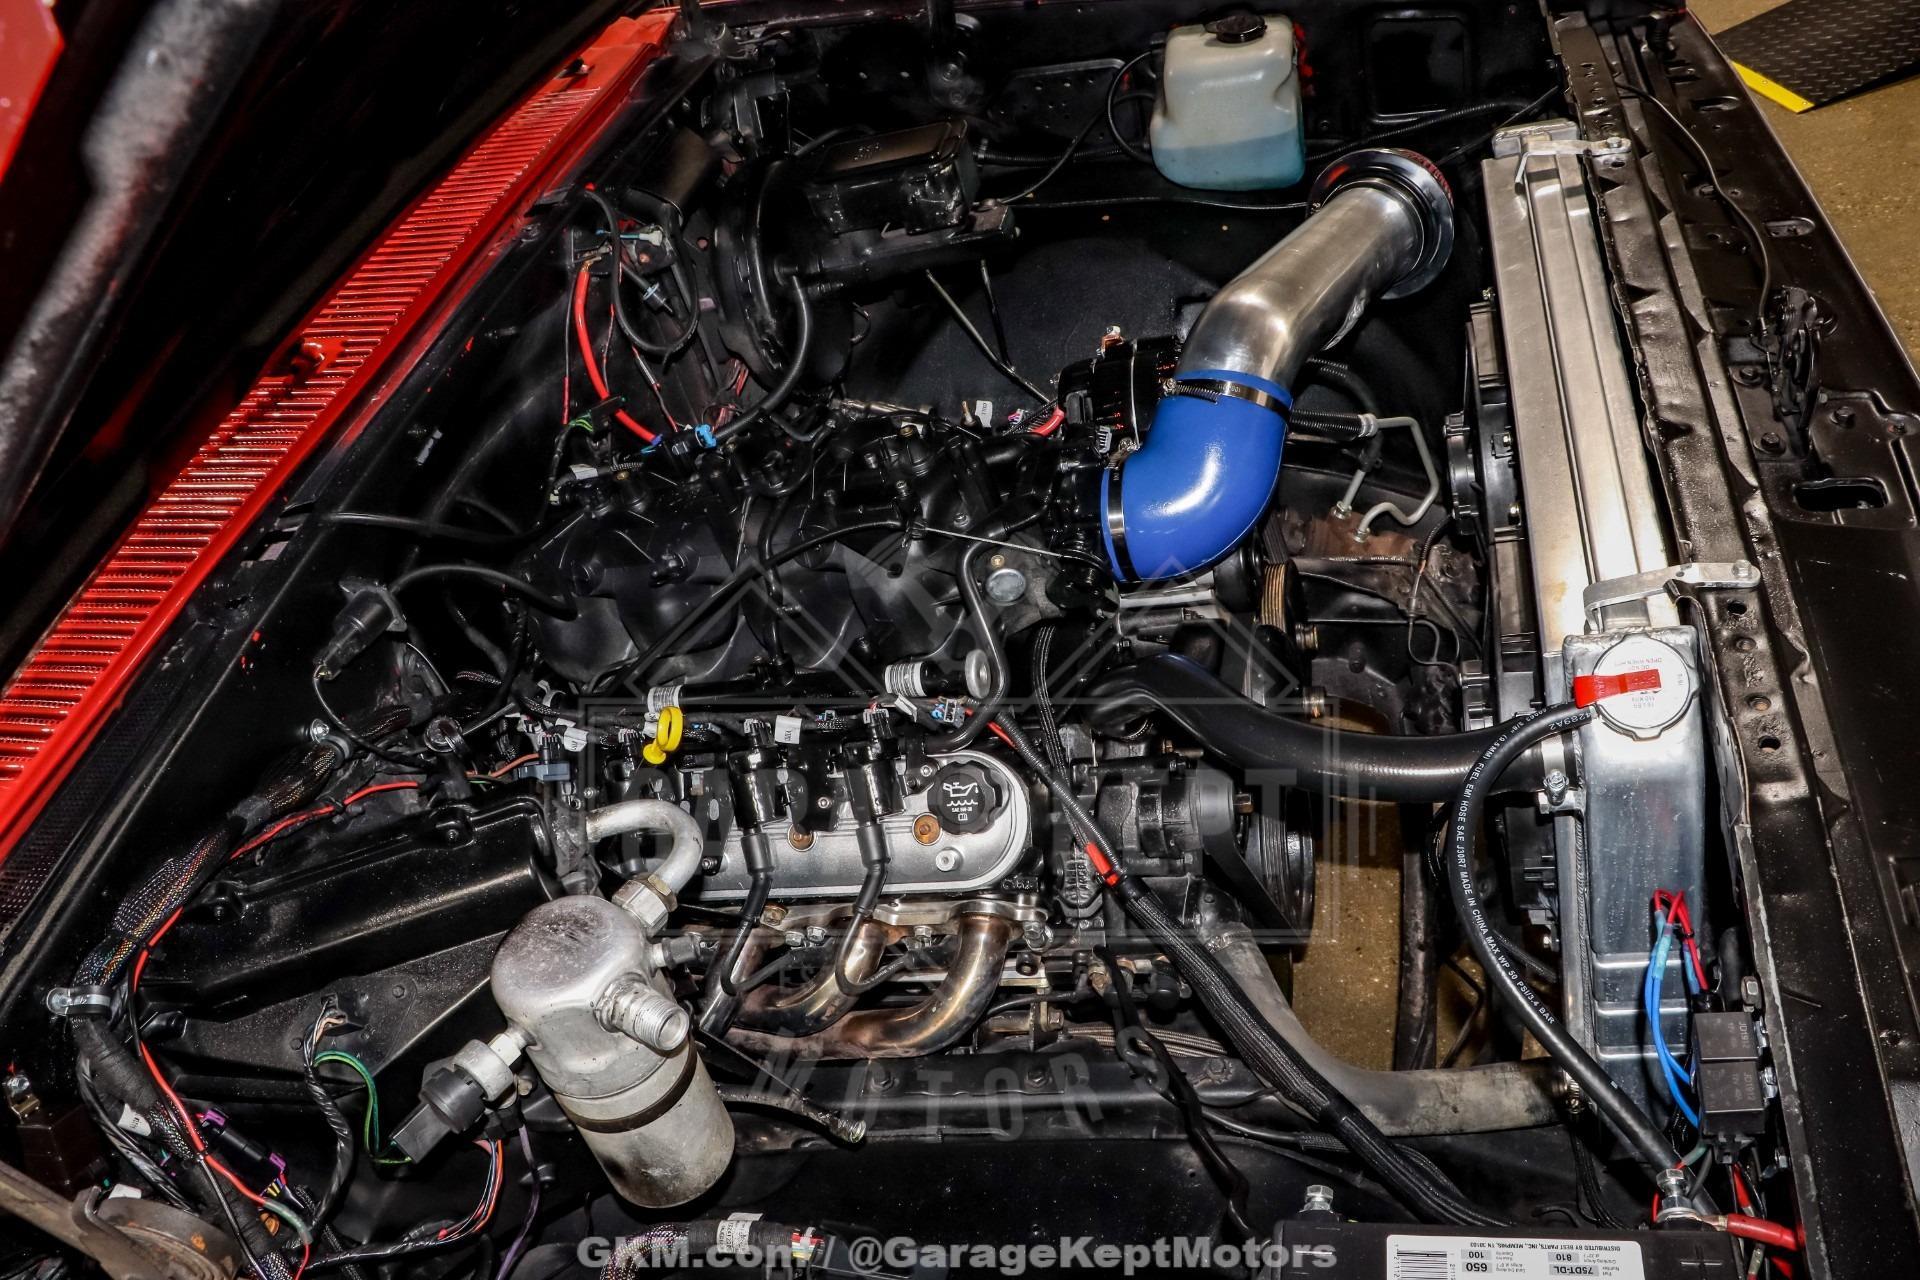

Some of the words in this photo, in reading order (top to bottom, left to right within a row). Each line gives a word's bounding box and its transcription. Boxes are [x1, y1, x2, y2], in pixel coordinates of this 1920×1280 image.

[1482, 734, 1508, 760] (9.5MM)
[1469, 762, 1485, 781] FUEL
[1463, 783, 1474, 799] EMI
[1458, 800, 1469, 823] HOSE
[1456, 825, 1465, 842] SAE
[1456, 844, 1467, 870] J30R7
[1460, 870, 1473, 895] MADE
[1466, 896, 1477, 909] IN
[1472, 908, 1489, 934] CHINA
[1486, 934, 1500, 956] MAX
[1498, 955, 1511, 970] WP
[1508, 970, 1519, 980] 50
[1516, 976, 1540, 1008] PSI/3.4
[1538, 1006, 1555, 1025] BAR
[1468, 1251, 1484, 1259] 100
[1584, 1244, 1621, 1252] DISTRIBUTED
[1556, 1253, 1572, 1261] 810
[1465, 1262, 1488, 1272] 650
[1553, 1265, 1594, 1275] 75DT-DL
